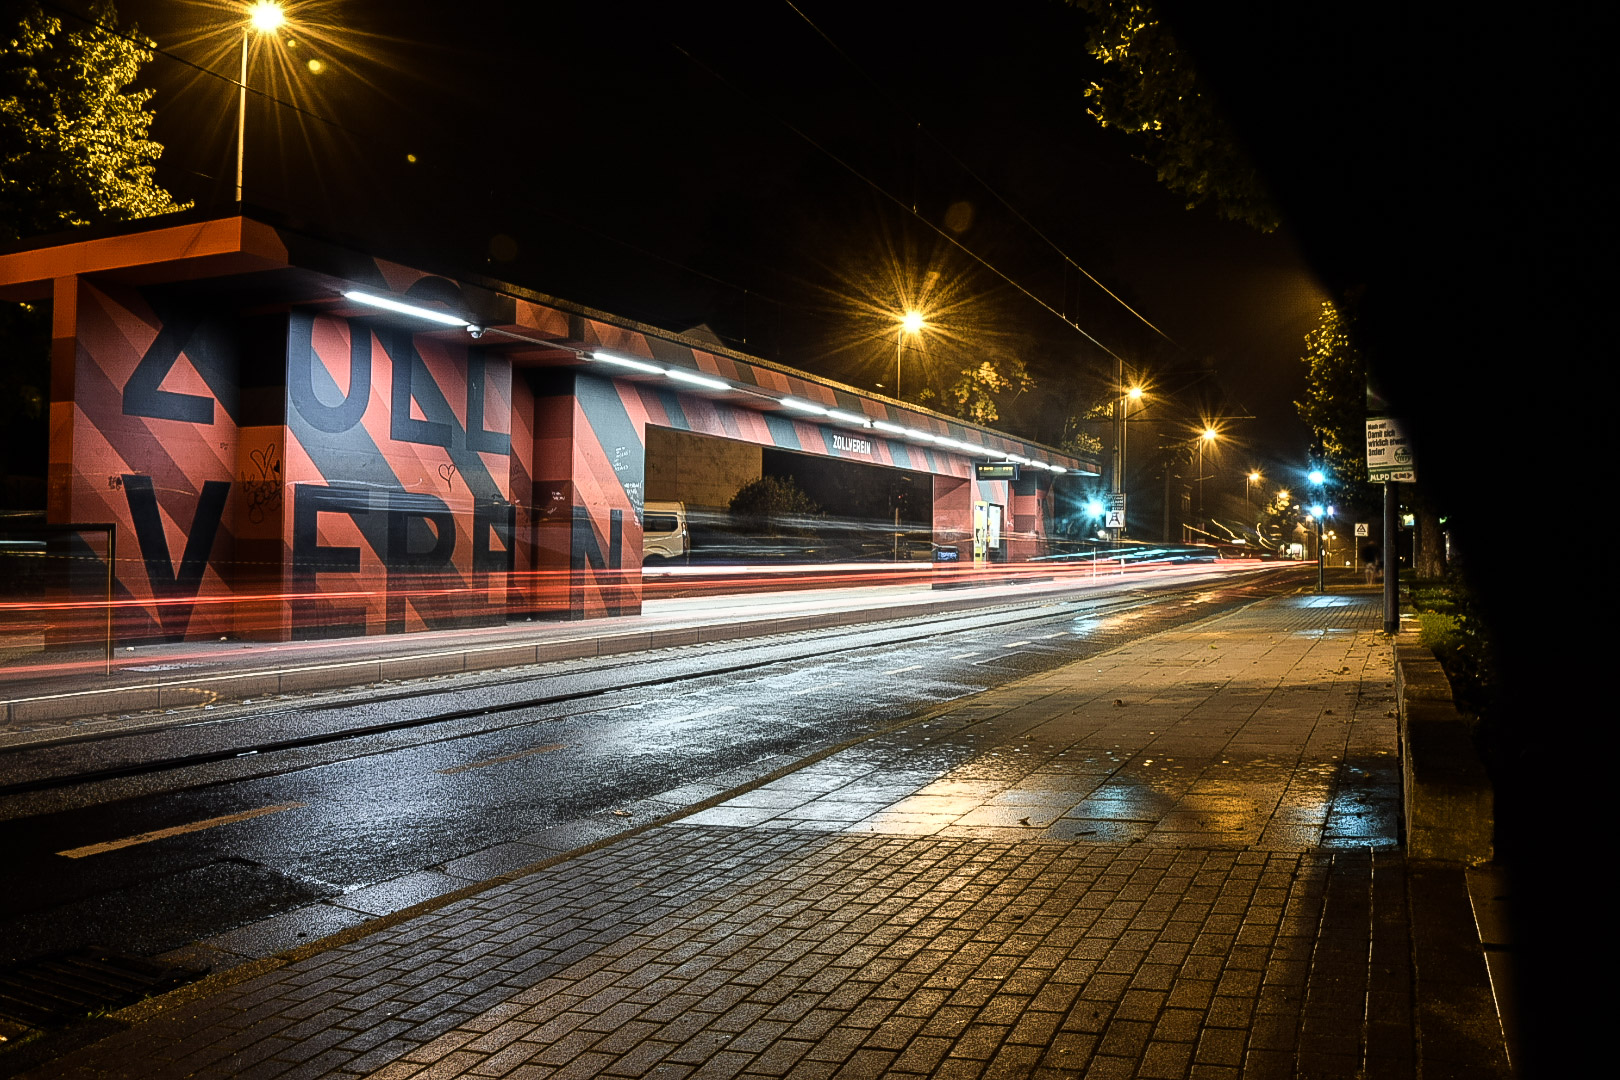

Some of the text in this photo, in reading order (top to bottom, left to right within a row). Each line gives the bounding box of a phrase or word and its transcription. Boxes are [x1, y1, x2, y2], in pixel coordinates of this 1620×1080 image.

[1368, 429, 1395, 439] Damit sich
[833, 434, 871, 455] ZOLLVEREIN
[1368, 439, 1388, 447] wirklich
[1370, 473, 1390, 482] MLPD
